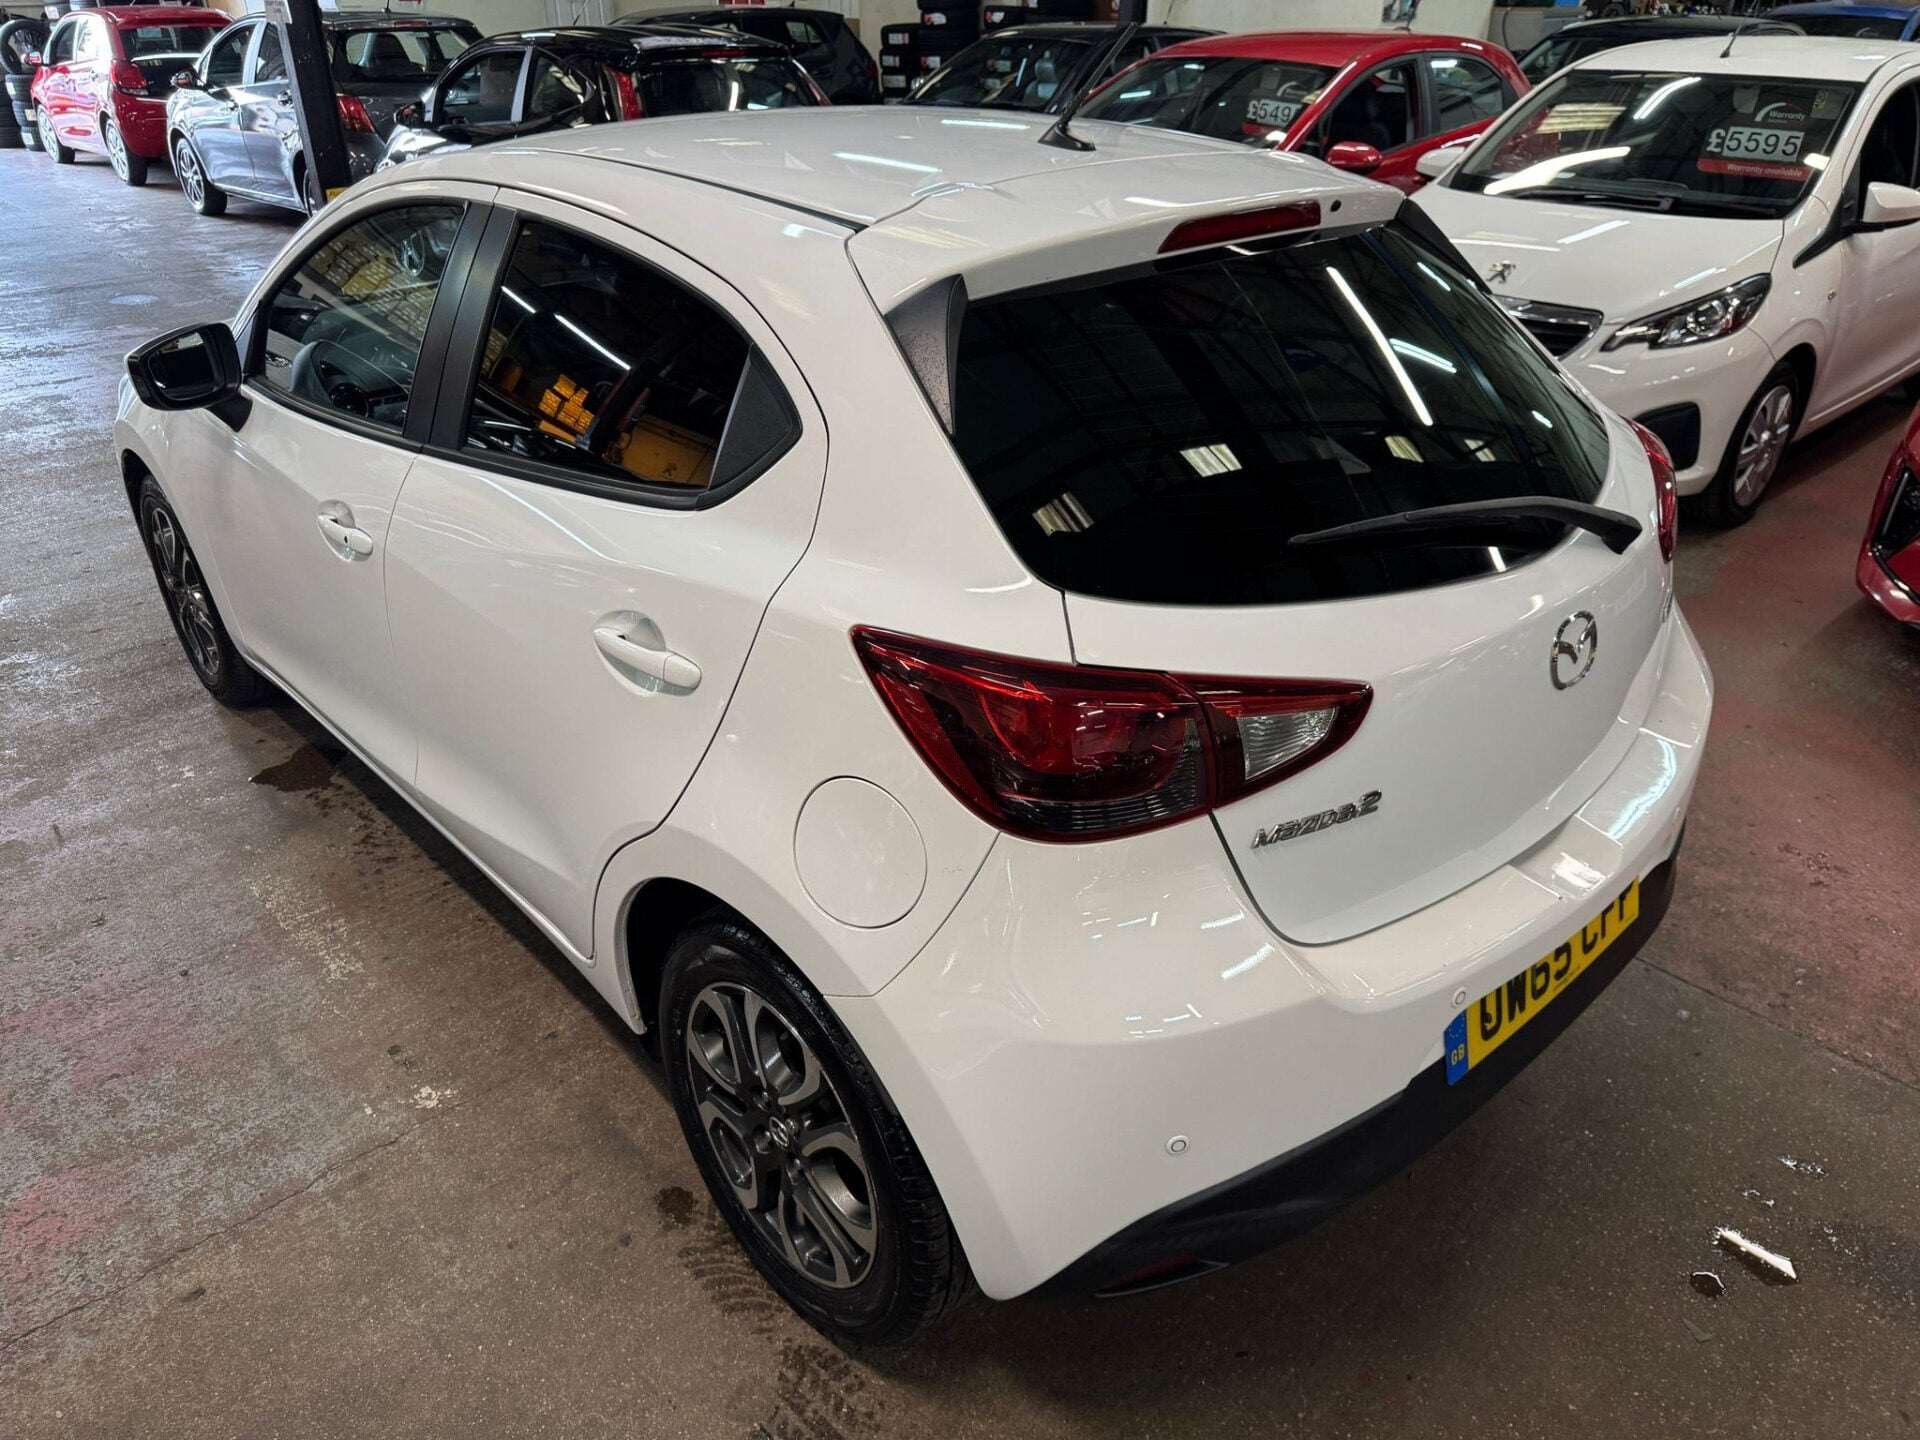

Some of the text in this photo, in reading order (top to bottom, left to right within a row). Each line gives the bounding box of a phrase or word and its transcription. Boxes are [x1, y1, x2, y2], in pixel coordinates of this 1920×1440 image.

[1246, 101, 1299, 124] £549
[1706, 129, 1801, 156] £5595
[1451, 1044, 1465, 1065] GB
